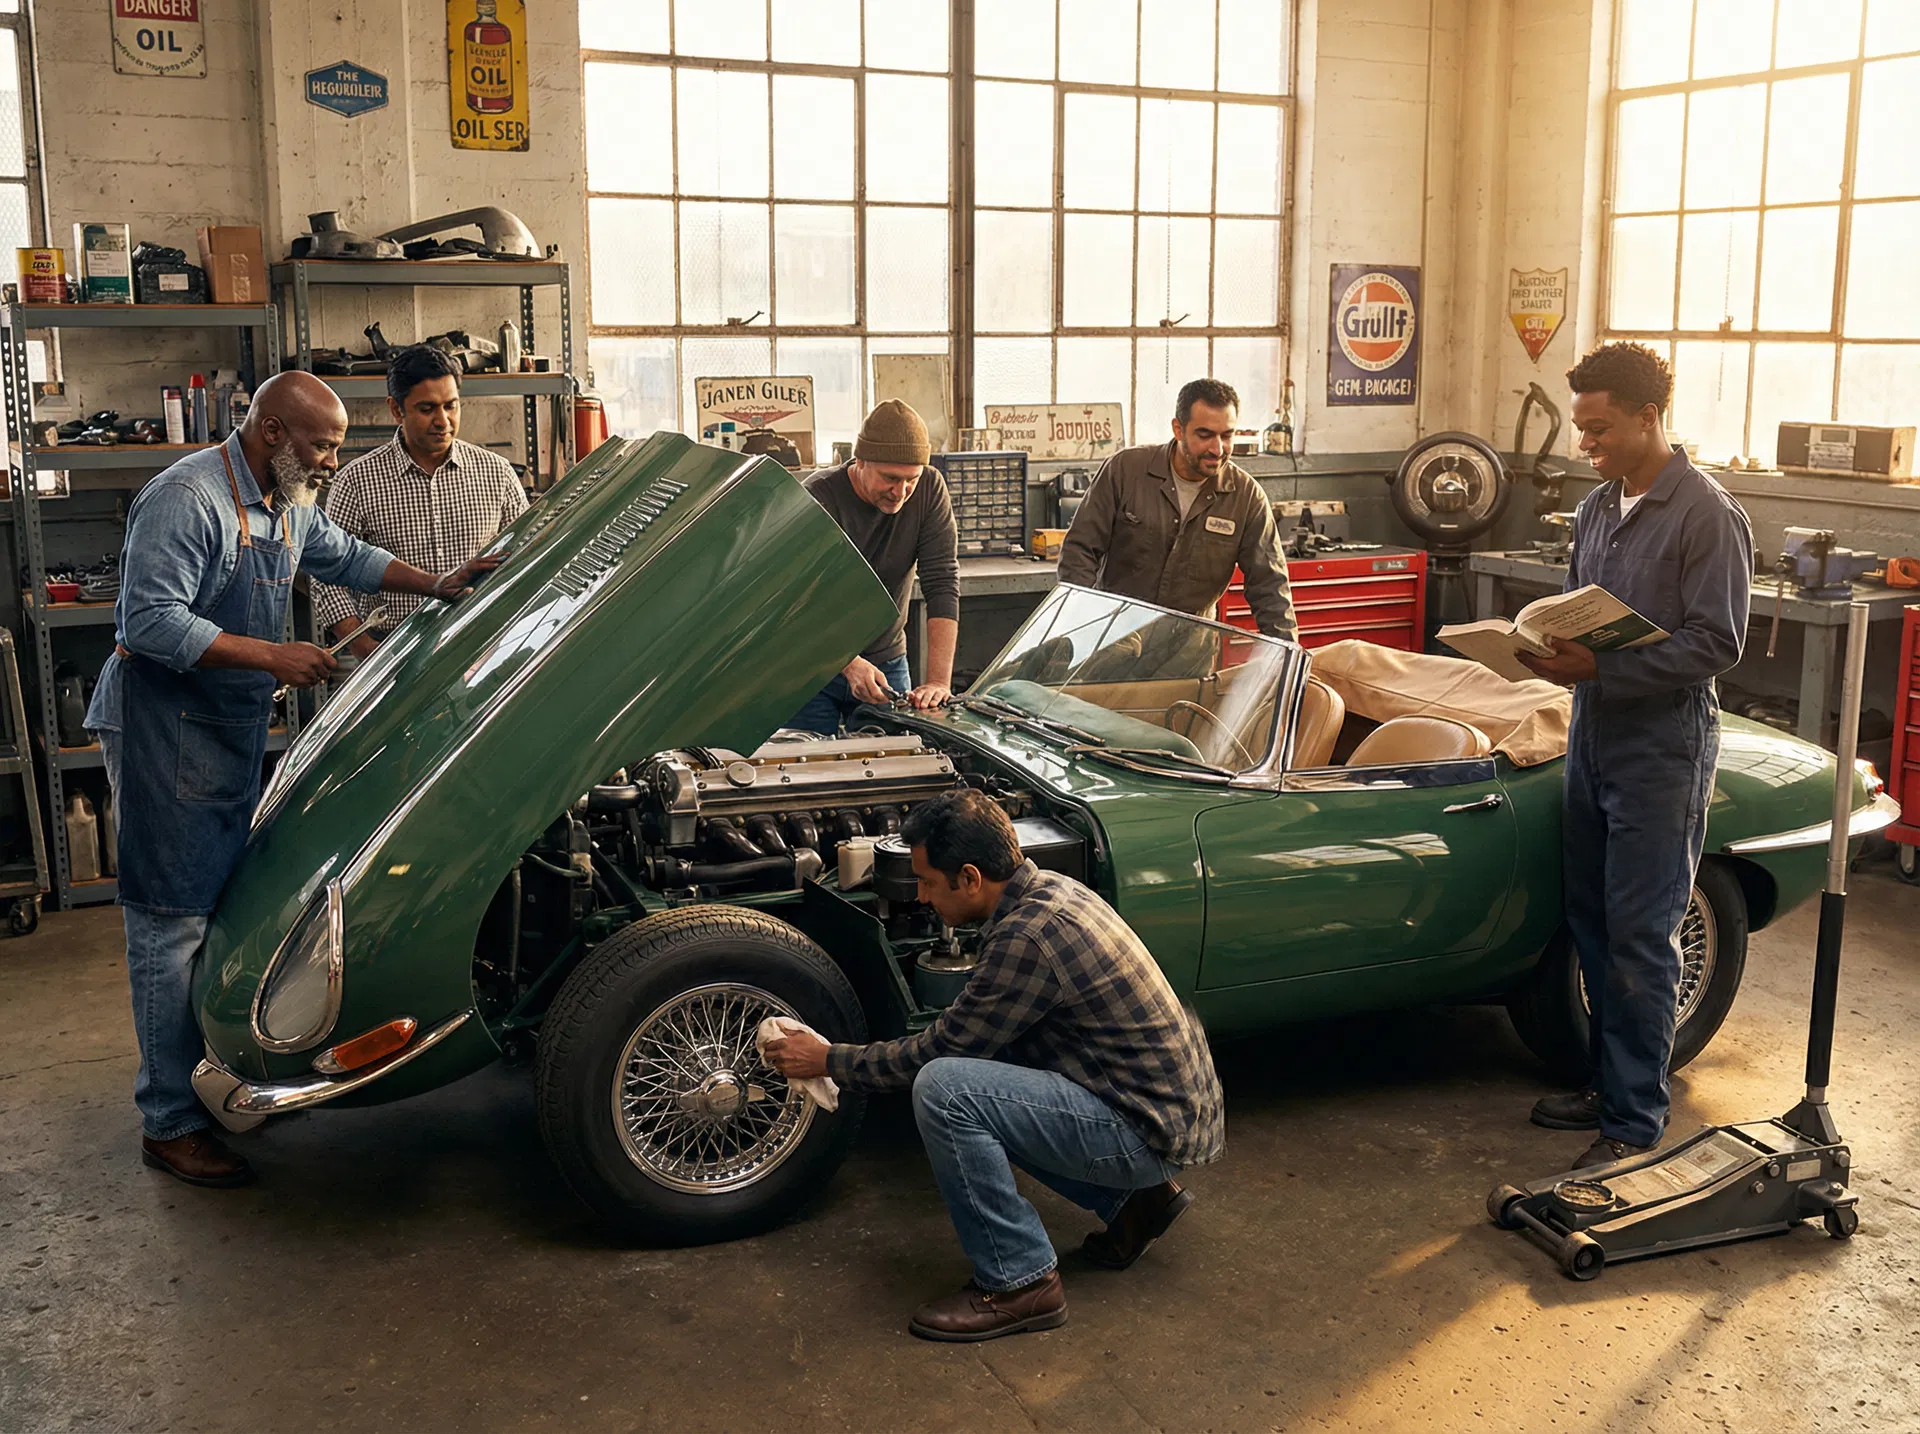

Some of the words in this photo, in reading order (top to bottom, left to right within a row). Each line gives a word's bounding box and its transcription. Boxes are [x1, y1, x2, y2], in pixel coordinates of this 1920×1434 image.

[124, 0, 191, 17] DANGER
[136, 28, 183, 52] OIL
[336, 71, 359, 82] THE
[471, 66, 506, 85] OIL
[457, 118, 489, 139] OIL
[494, 120, 525, 141] SER
[703, 384, 756, 409] JANEN
[761, 381, 808, 406] GILER
